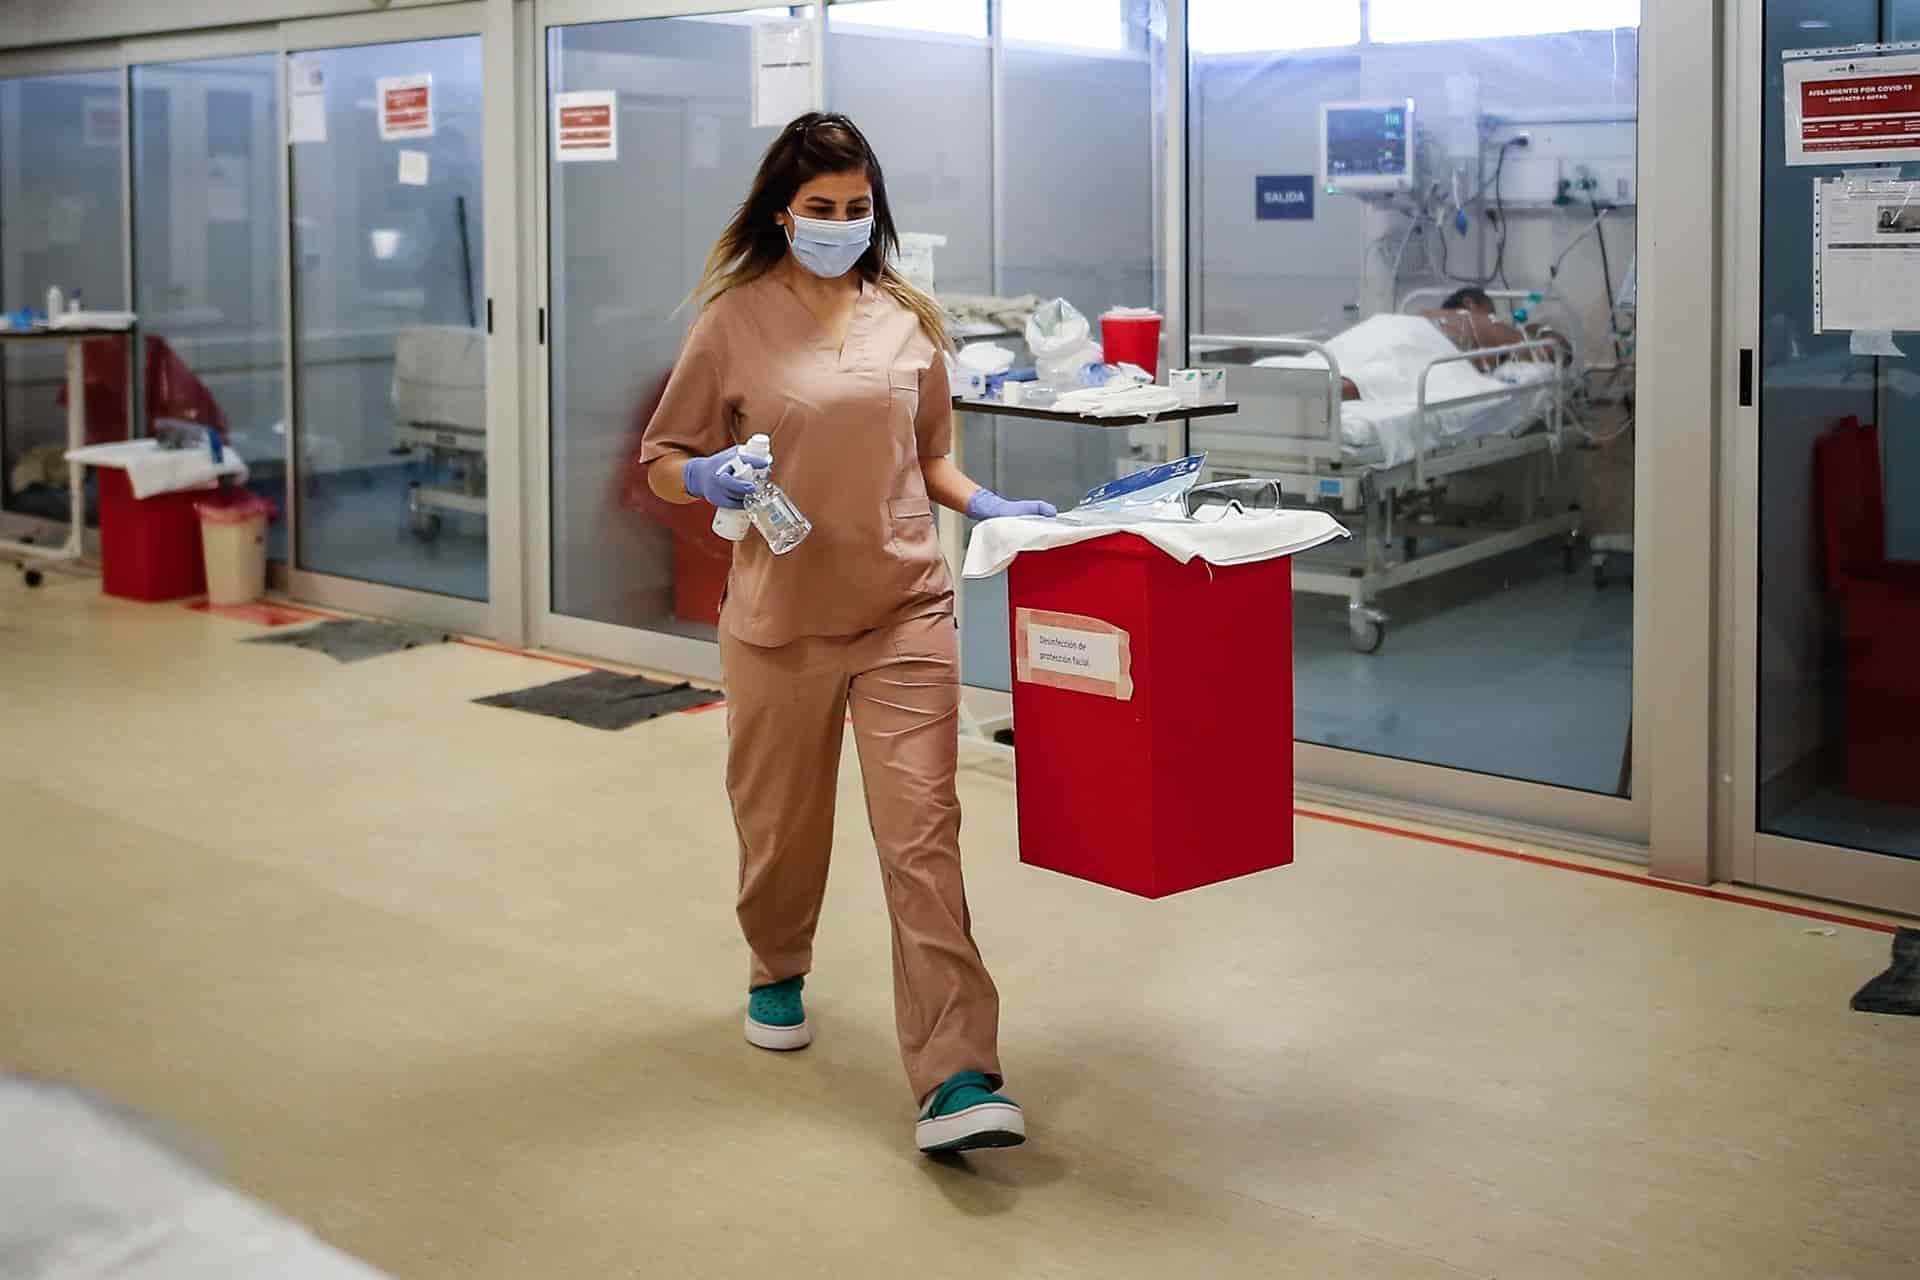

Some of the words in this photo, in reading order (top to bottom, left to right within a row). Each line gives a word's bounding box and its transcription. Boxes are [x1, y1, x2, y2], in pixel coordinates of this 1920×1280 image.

[1808, 88, 1858, 96] AISLAMIENTO
[1877, 84, 1912, 92] COVID-19
[1263, 191, 1305, 203] SALIDA
